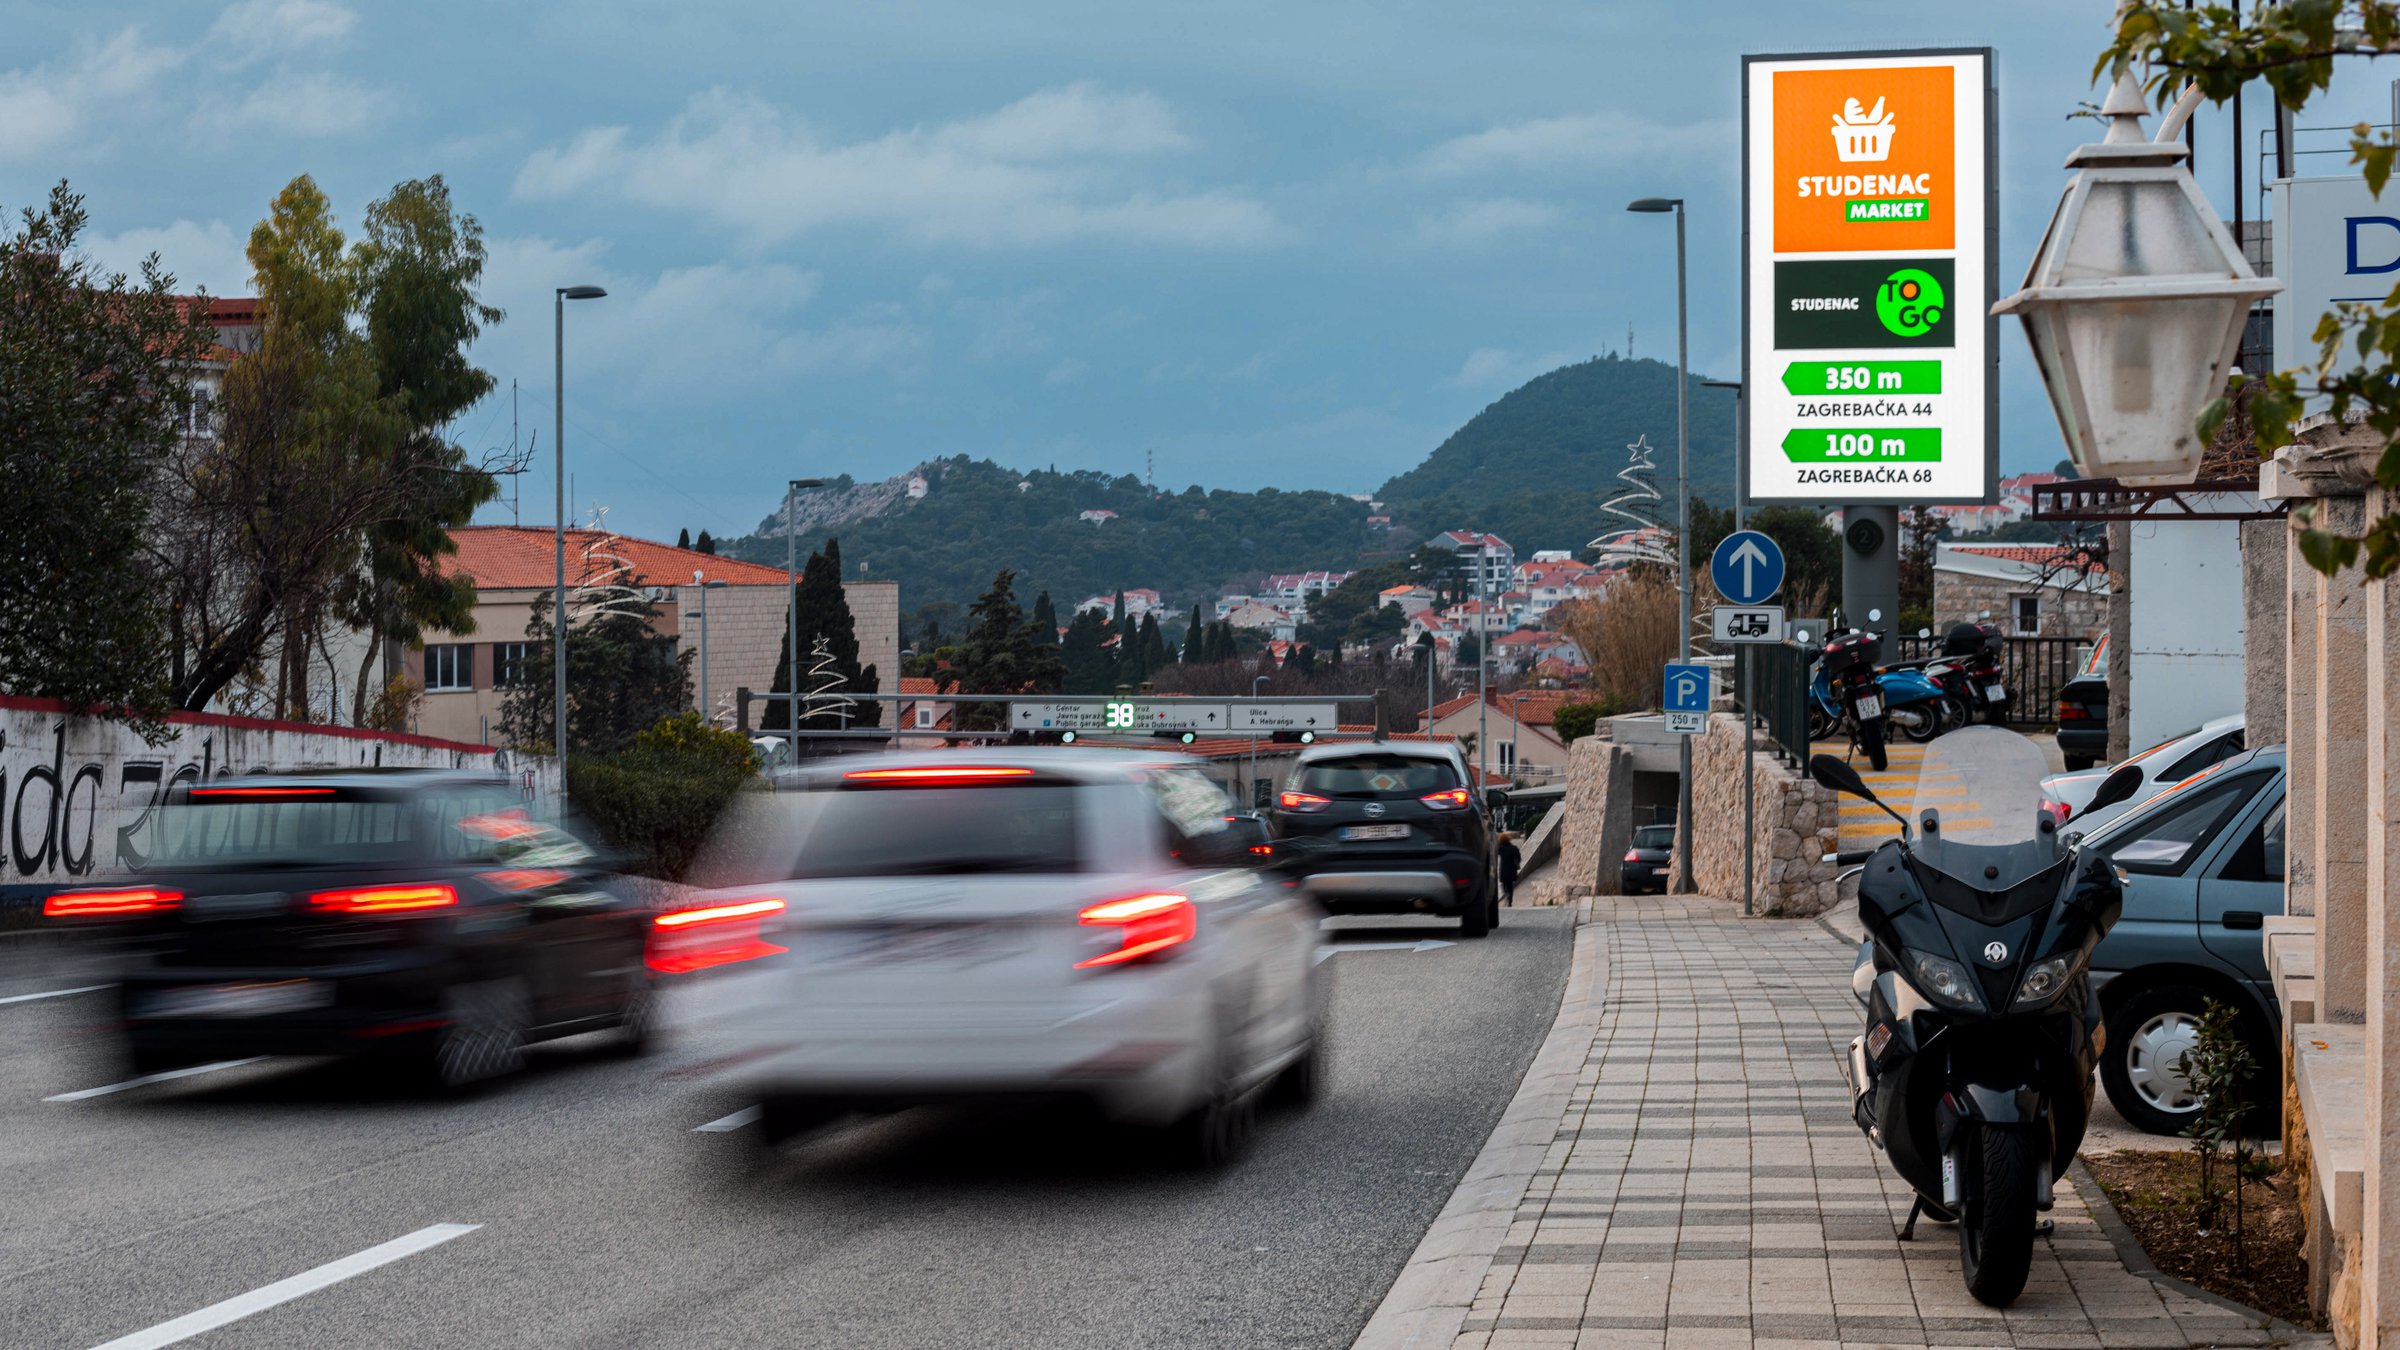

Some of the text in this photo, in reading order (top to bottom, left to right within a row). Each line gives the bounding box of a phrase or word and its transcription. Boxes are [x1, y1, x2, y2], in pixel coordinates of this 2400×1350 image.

[1798, 173, 1930, 197] STUDENAC
[1850, 202, 1924, 218] MARKET
[1883, 280, 1921, 302] TO
[1791, 297, 1859, 311] STUDENAC
[1898, 305, 1941, 328] GO
[1825, 367, 1902, 390] 350 m
[1798, 399, 1932, 417] ZAGREBAČKA 44
[1825, 435, 1905, 457] 100 m
[1798, 466, 1932, 484] ZAGREBAČKA 68
[1677, 679, 1696, 706] P
[1056, 720, 1078, 728] Public
[1106, 703, 1135, 728] 38
[1671, 714, 1699, 725] 250 m
